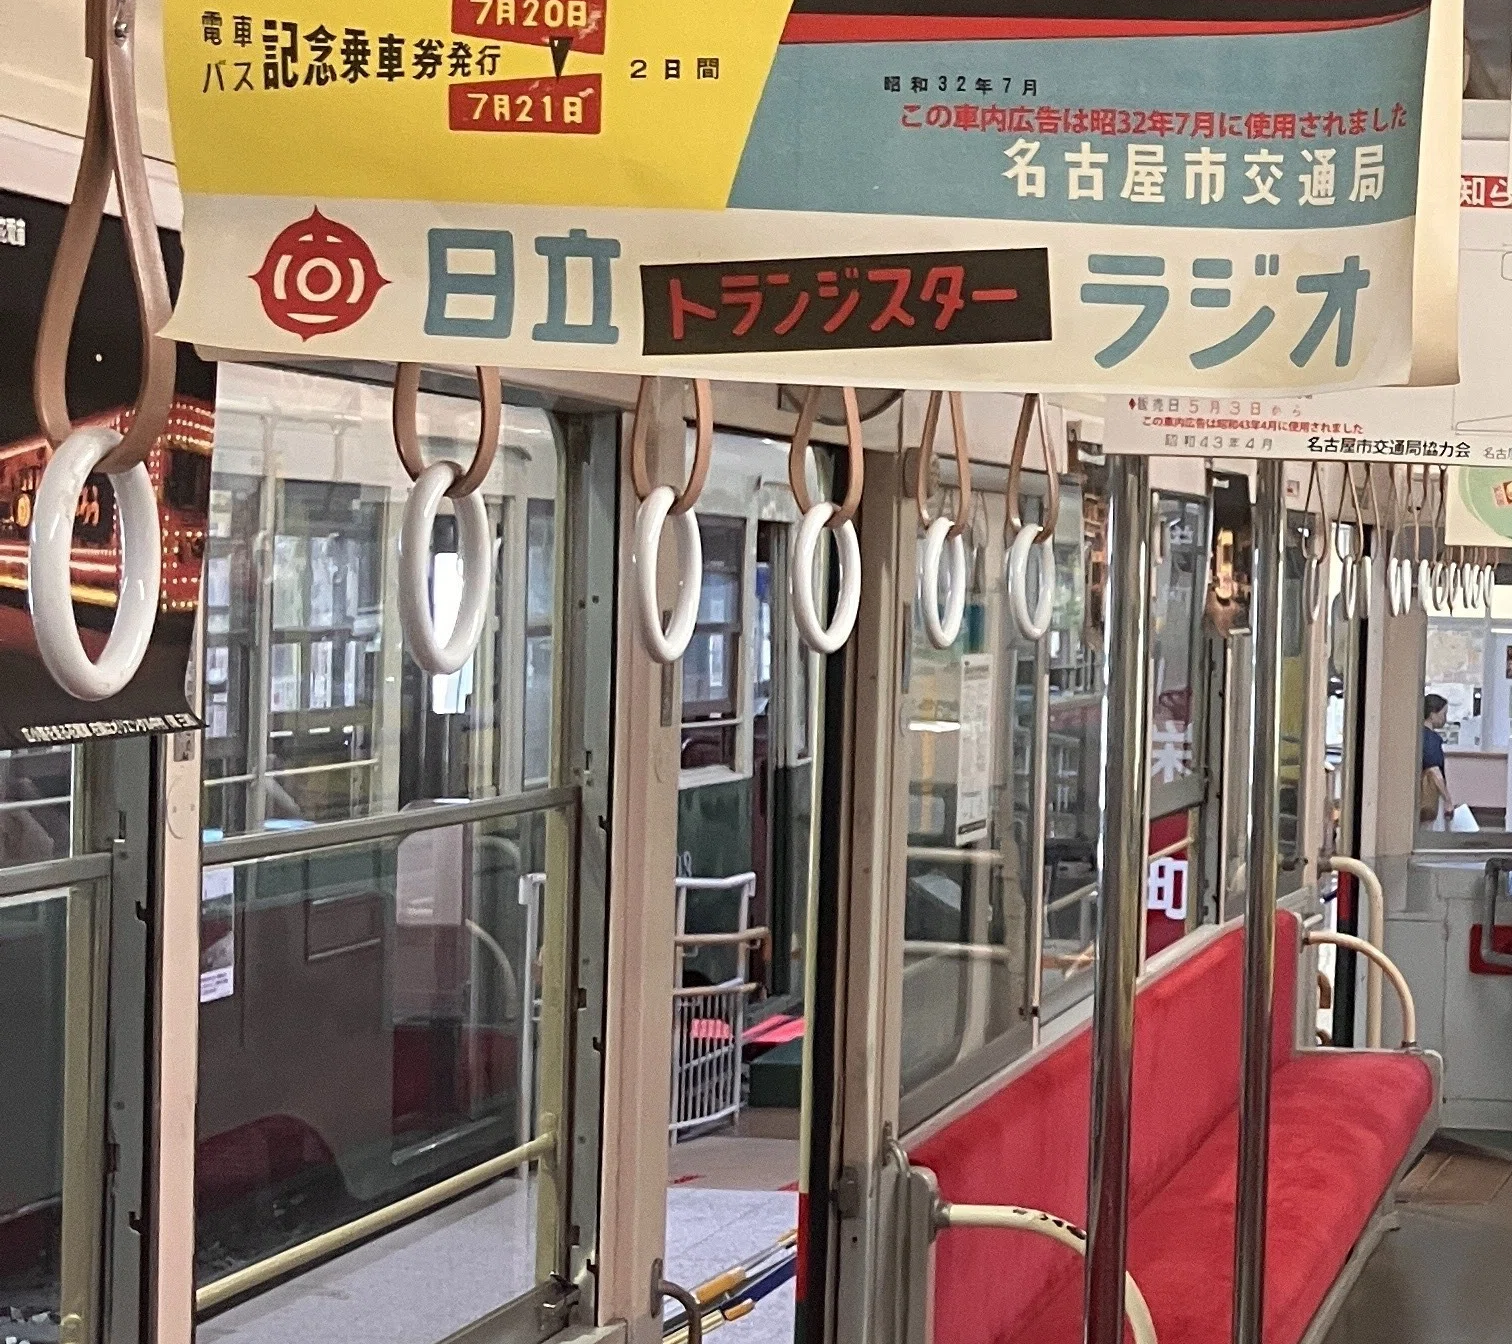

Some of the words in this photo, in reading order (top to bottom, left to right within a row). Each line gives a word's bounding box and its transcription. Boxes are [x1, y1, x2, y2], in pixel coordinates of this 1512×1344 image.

[201, 11, 253, 47] 電車
[263, 19, 501, 90] 記念乗車券発行
[630, 58, 720, 80] 2日間
[203, 60, 255, 93] バス
[884, 76, 1038, 96] 昭和32年7月
[466, 94, 583, 125] 7月21日
[1001, 138, 1385, 206] 名古屋市交通局
[424, 228, 621, 344] 日立
[668, 265, 1019, 340] トランジスター
[1080, 254, 1370, 368] ラジオ
[1308, 437, 1471, 457] 名古屋市交通局協力会
